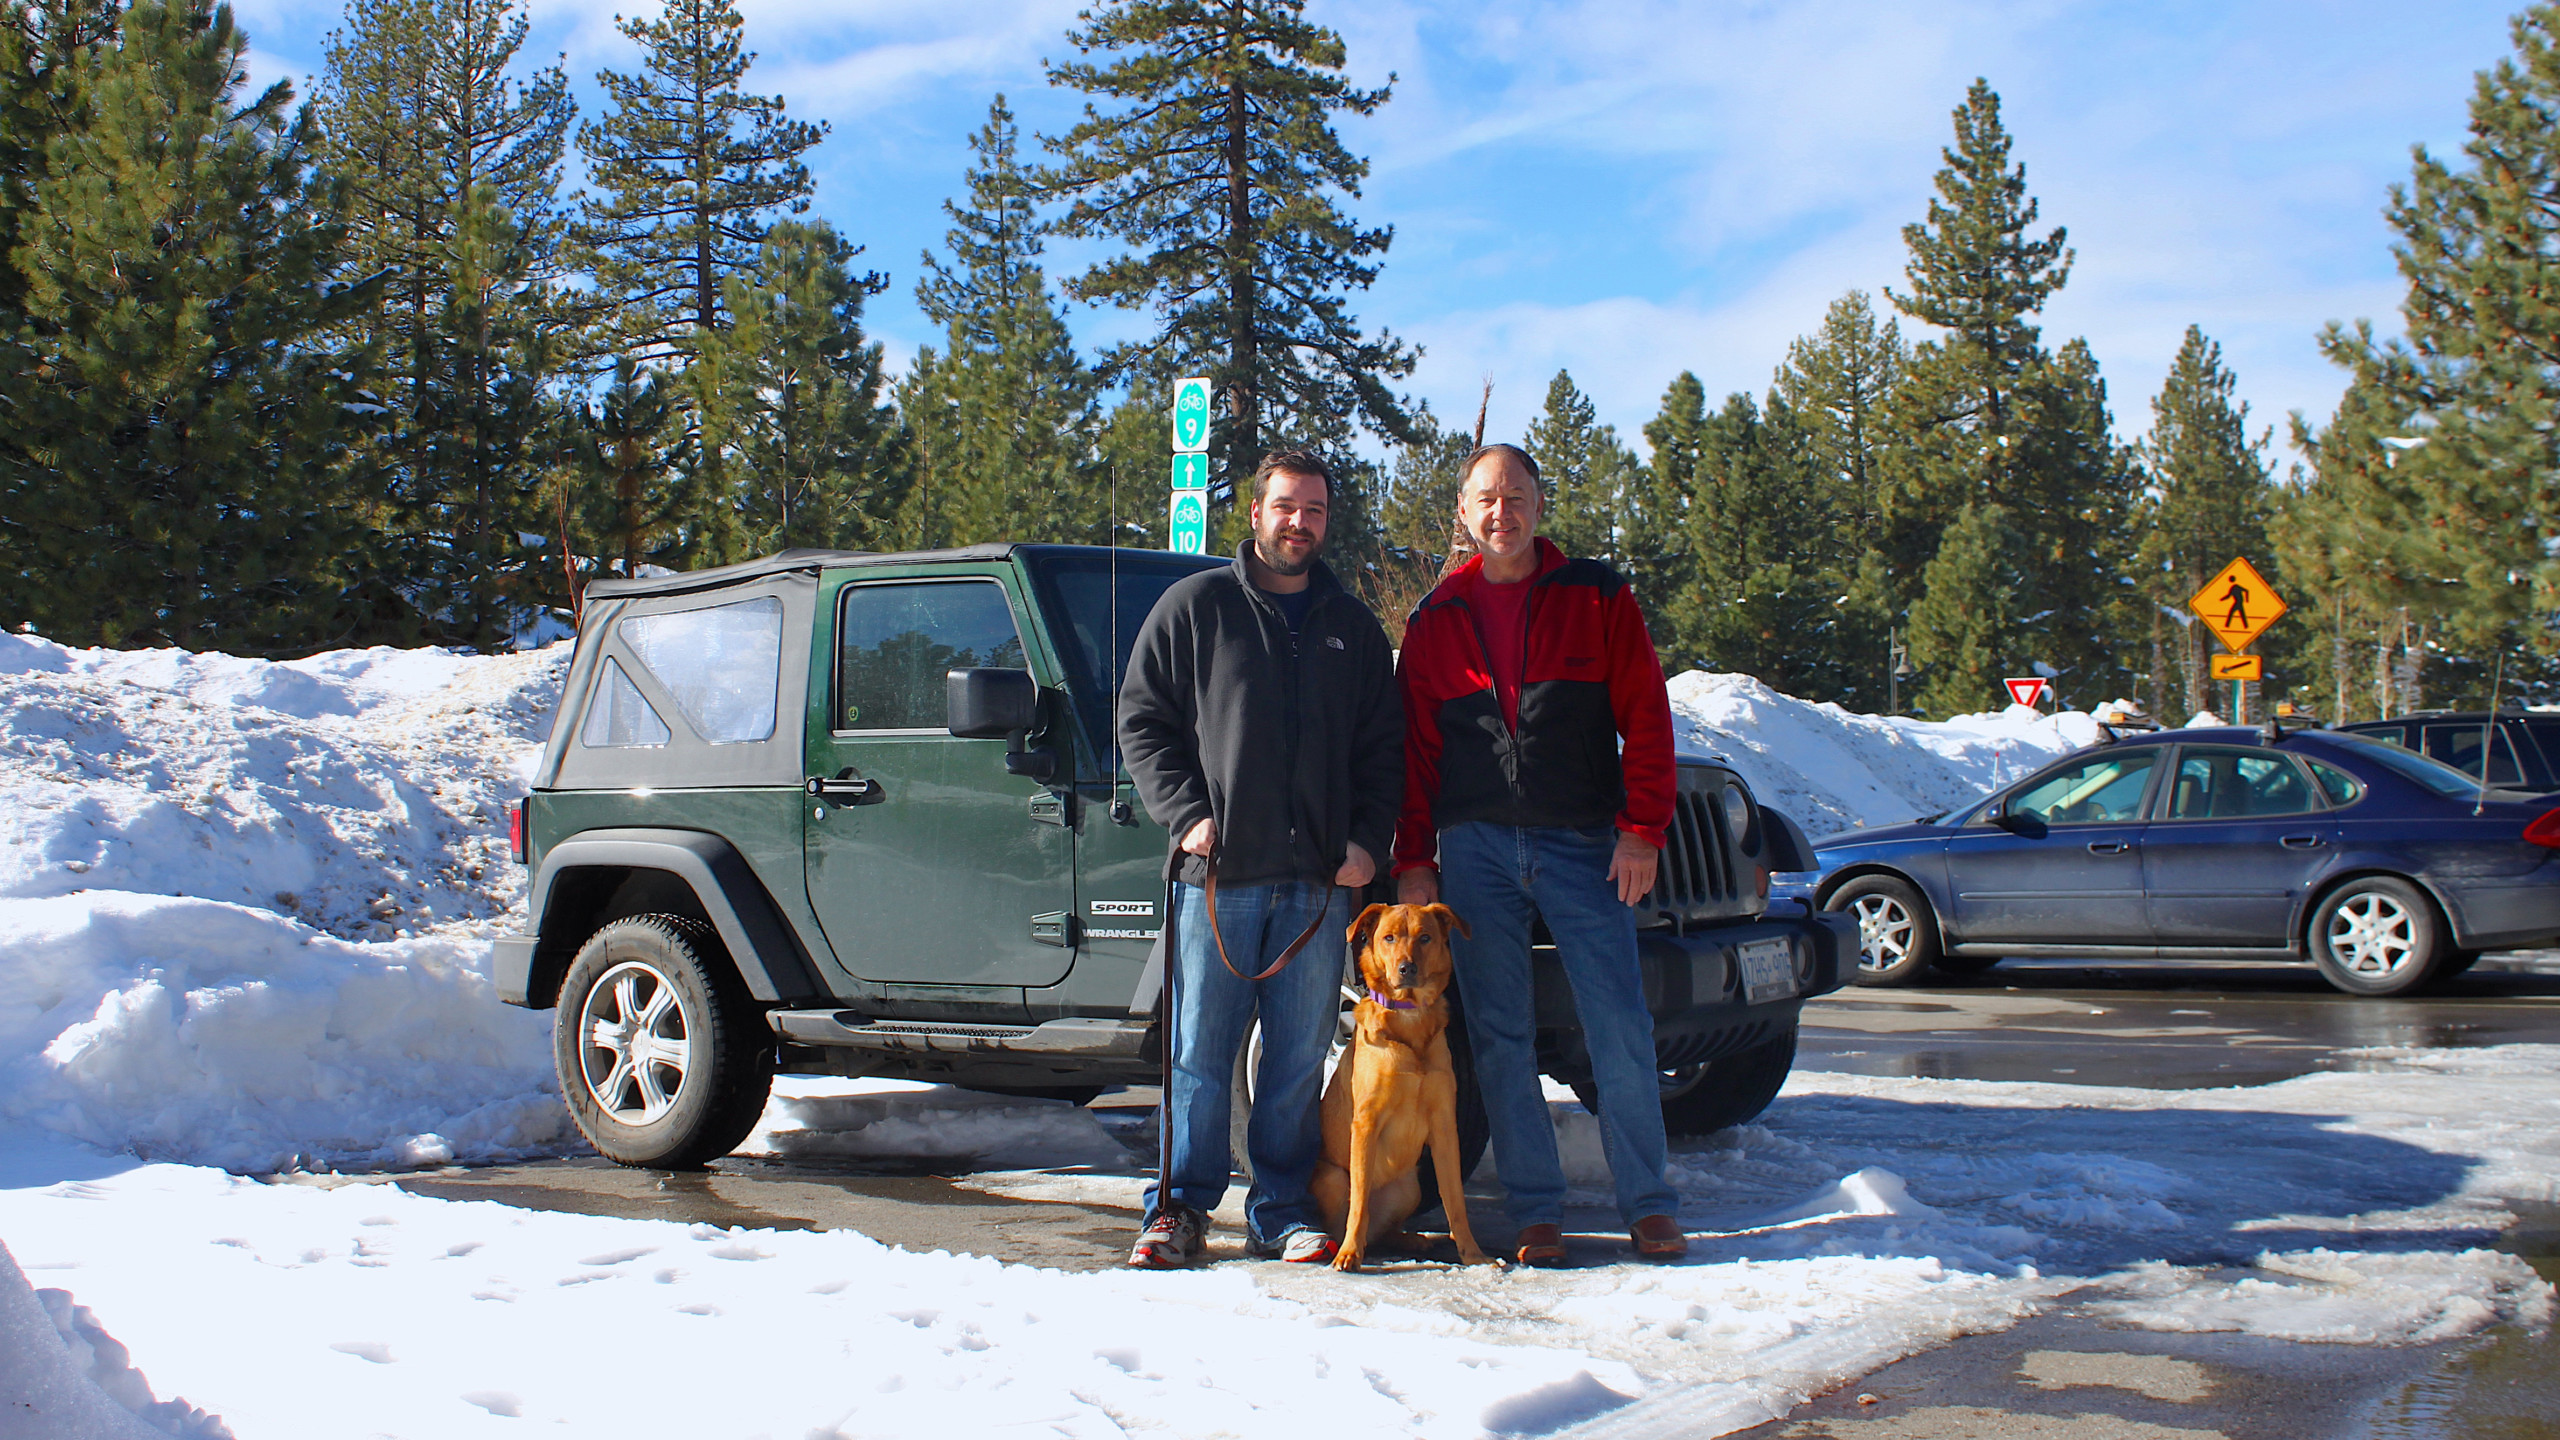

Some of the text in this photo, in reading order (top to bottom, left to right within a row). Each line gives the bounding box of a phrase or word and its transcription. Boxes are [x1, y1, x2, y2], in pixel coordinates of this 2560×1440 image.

[1185, 418, 1197, 439] 9
[1178, 530, 1196, 553] 10
[1092, 903, 1153, 912] SPORT
